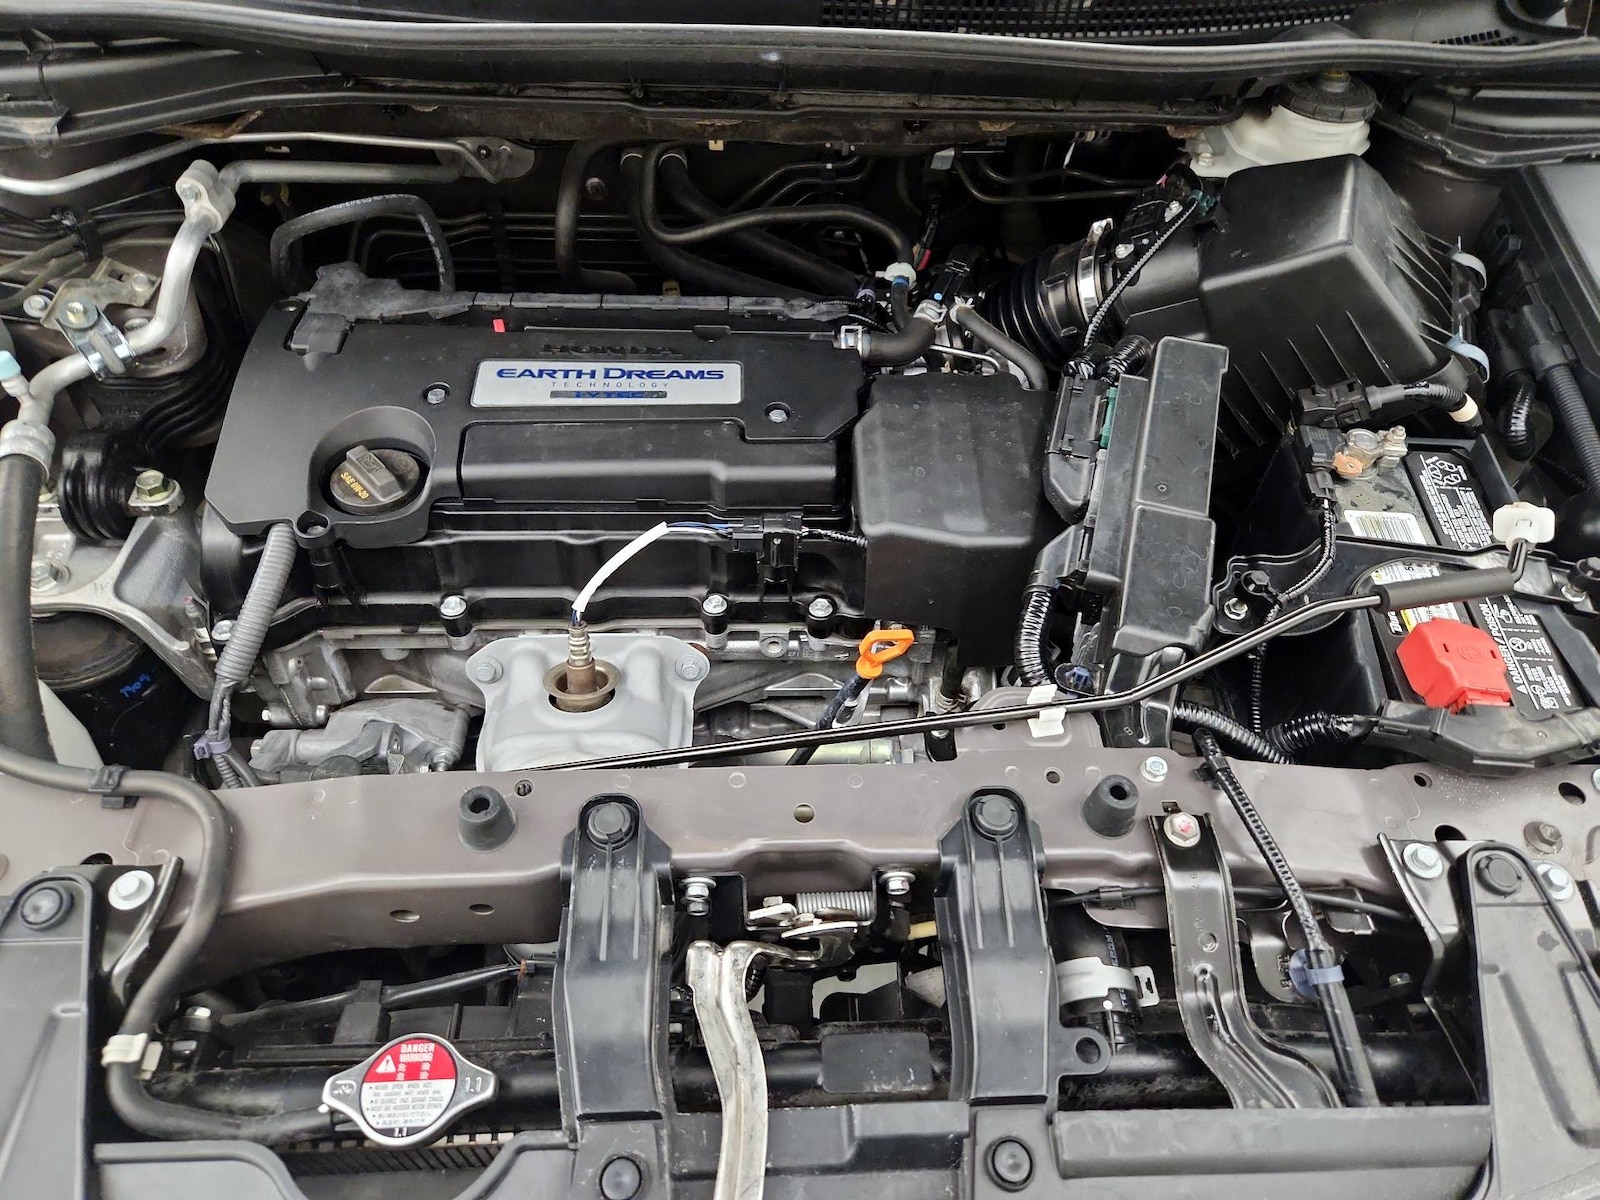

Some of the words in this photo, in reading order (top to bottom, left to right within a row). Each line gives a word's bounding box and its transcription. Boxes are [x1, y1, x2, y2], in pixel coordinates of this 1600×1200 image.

[496, 368, 596, 380] EARTH
[603, 367, 725, 380] DREAMS
[340, 471, 355, 485] SAE
[351, 482, 369, 499] 0W-20
[400, 1042, 436, 1054] DANGER
